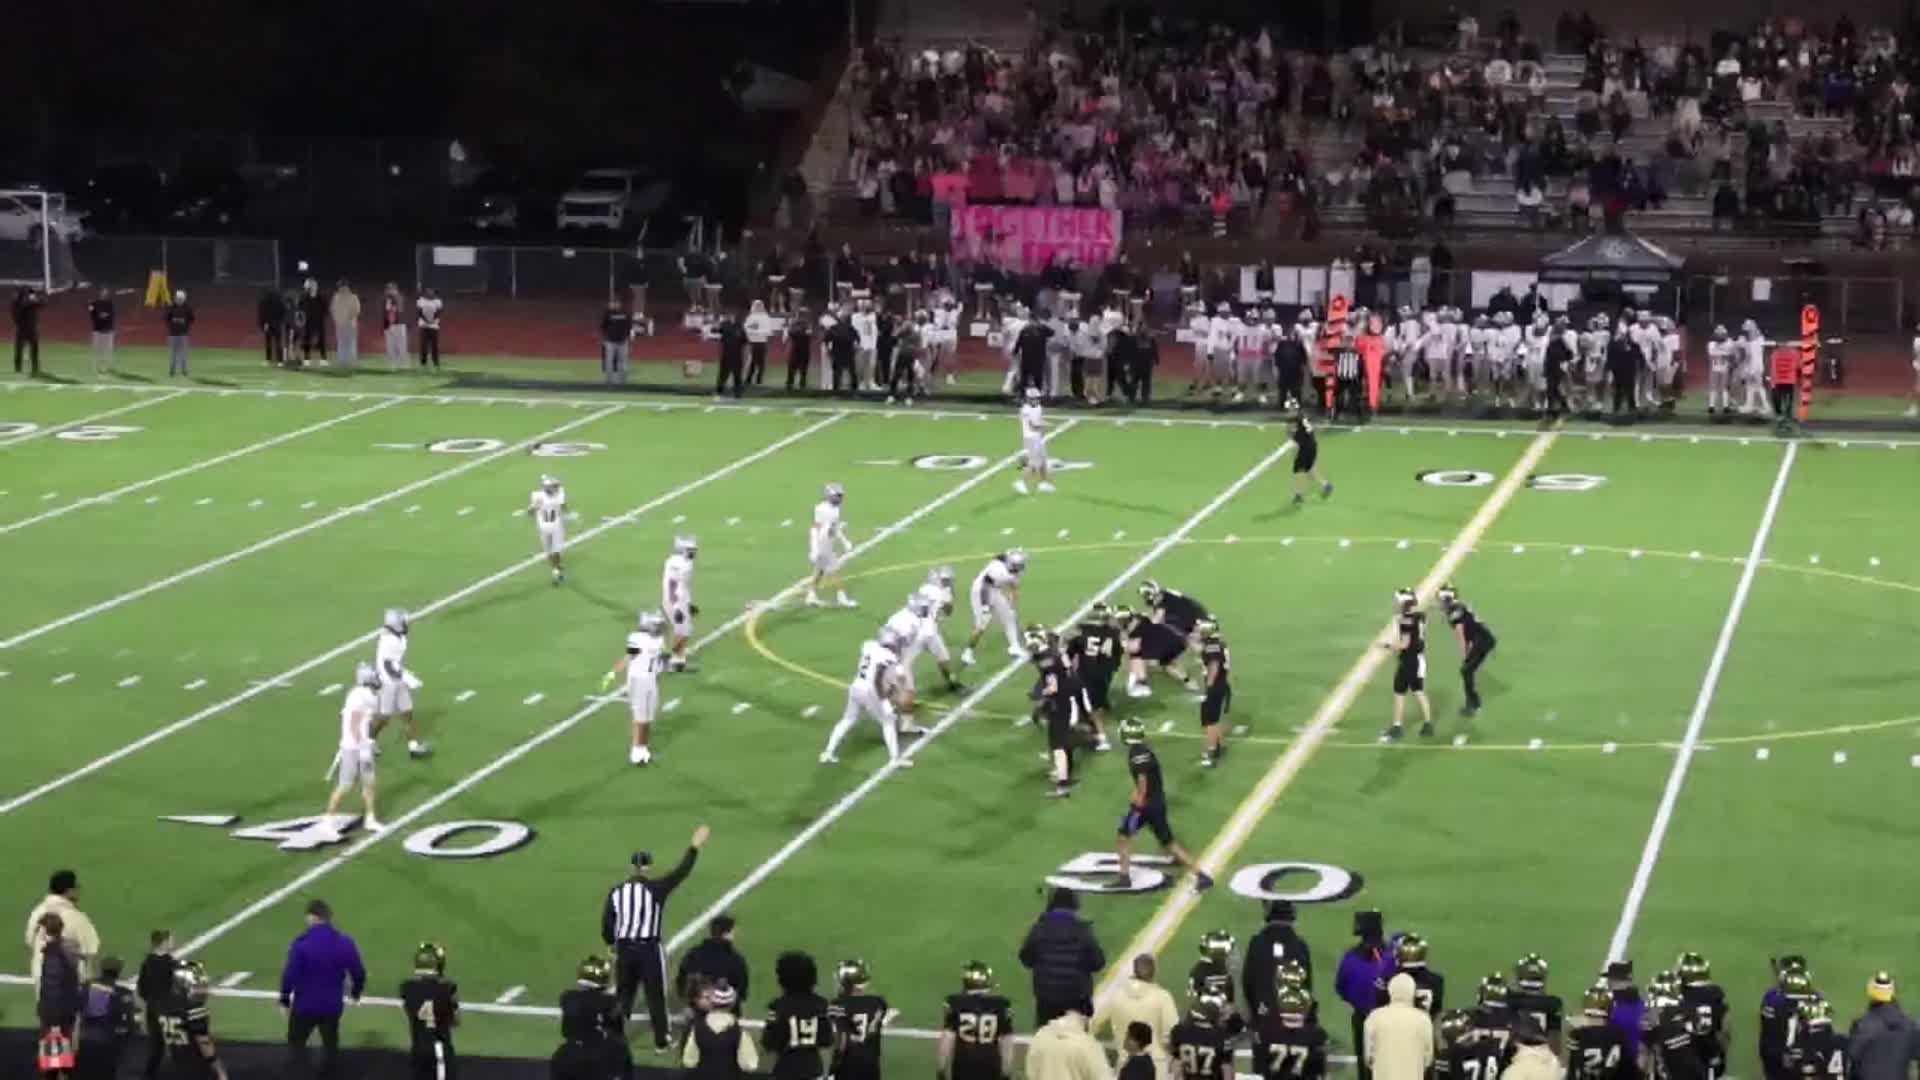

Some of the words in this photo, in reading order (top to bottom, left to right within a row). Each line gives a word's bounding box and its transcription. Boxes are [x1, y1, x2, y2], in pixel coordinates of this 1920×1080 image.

[1085, 636, 1114, 656] 54
[418, 1000, 436, 1028] 4
[1269, 1044, 1308, 1074] 77
